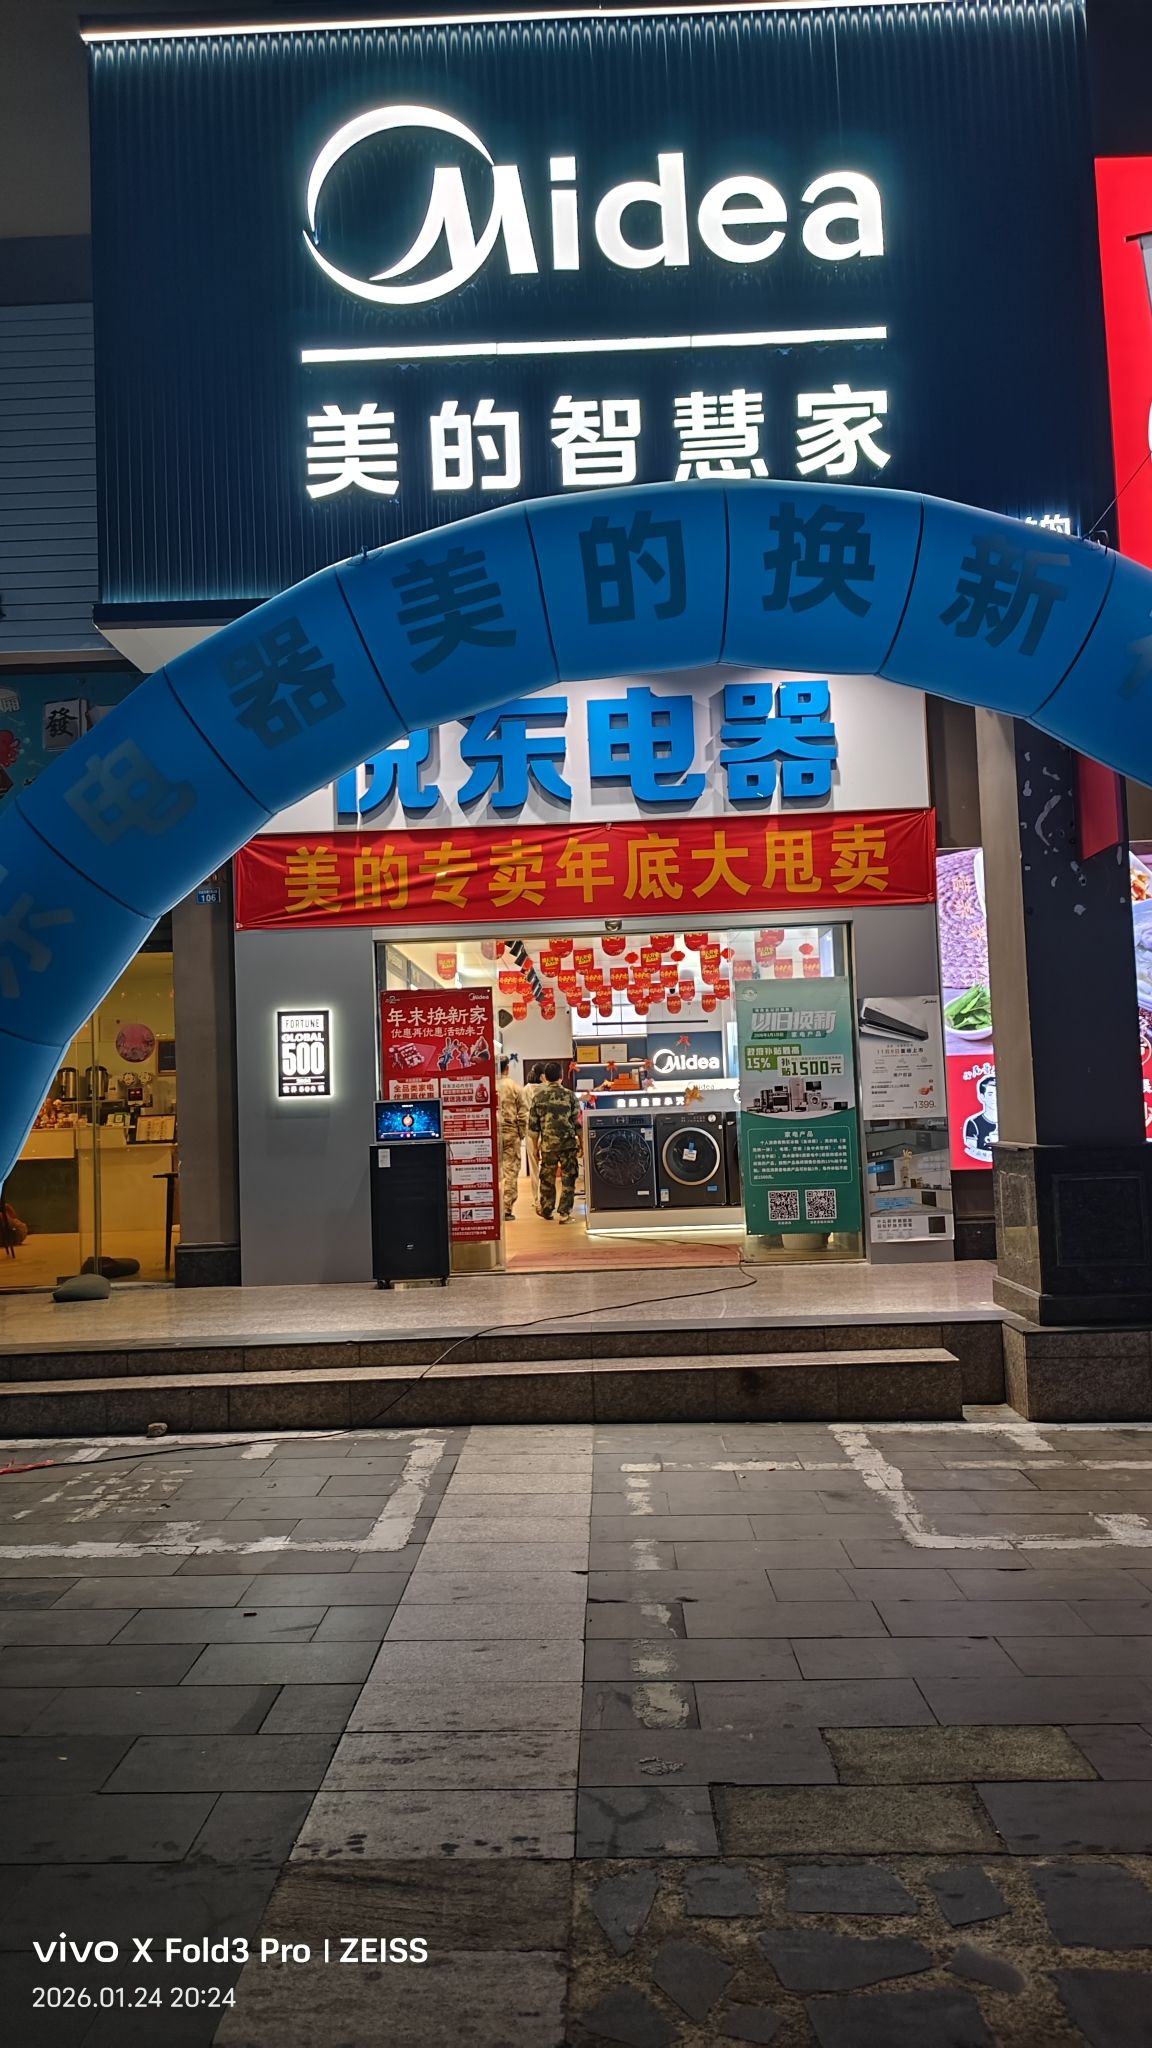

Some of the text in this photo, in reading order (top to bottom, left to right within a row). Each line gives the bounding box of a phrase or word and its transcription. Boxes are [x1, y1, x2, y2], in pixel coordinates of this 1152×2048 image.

[303, 105, 885, 305] Midea
[304, 384, 892, 499] 美的智慧家
[284, 824, 889, 913] 美的专卖年底大甩卖
[285, 1018, 320, 1029] FORTUNE
[386, 1005, 489, 1027] 年末换新家
[751, 1010, 837, 1034] 以旧换新
[281, 1032, 325, 1043] GLOBAL
[281, 1041, 325, 1076] 500
[653, 1048, 720, 1074] Midea
[747, 1057, 771, 1069] 15%
[791, 1060, 842, 1076] 1500元
[913, 1100, 935, 1109] 1399
